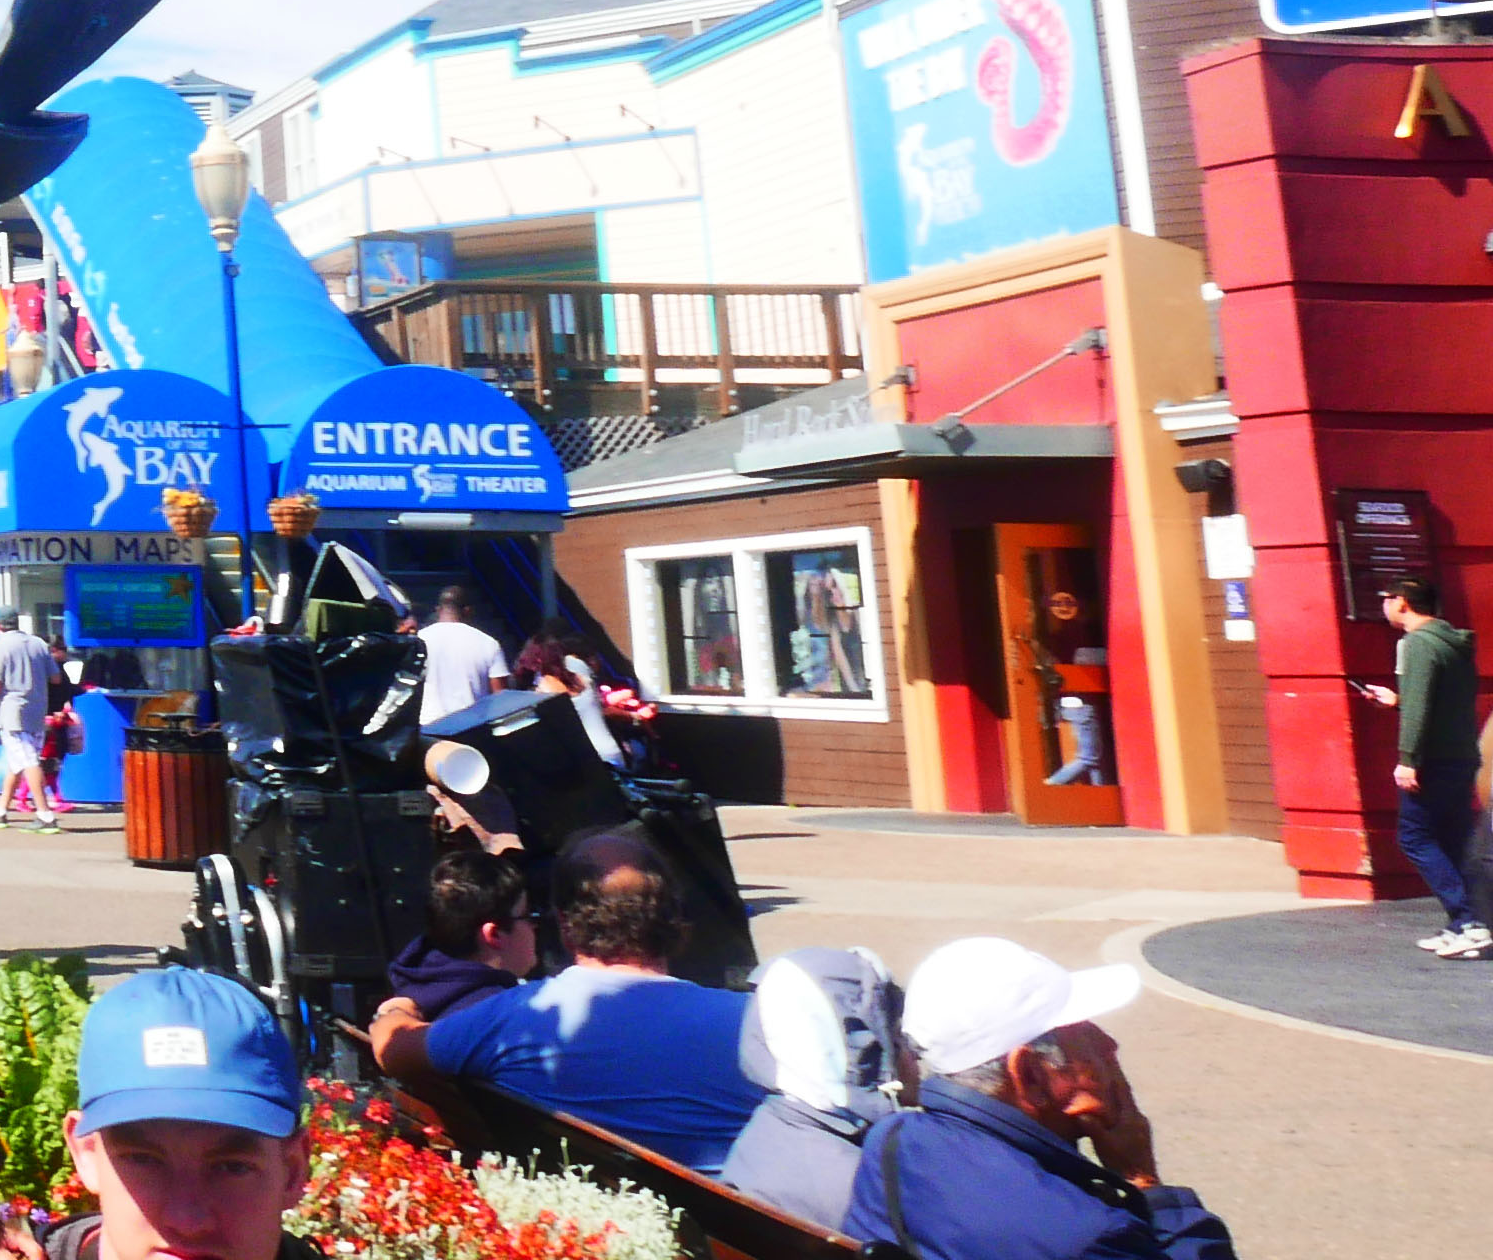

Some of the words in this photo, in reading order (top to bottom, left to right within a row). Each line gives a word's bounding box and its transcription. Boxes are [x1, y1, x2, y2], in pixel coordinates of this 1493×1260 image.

[313, 421, 534, 458] ENTRANCE
[133, 446, 219, 485] BAY
[305, 473, 408, 492] AQUARIUM
[464, 475, 548, 494] THEATER
[115, 537, 194, 564] MAPS
